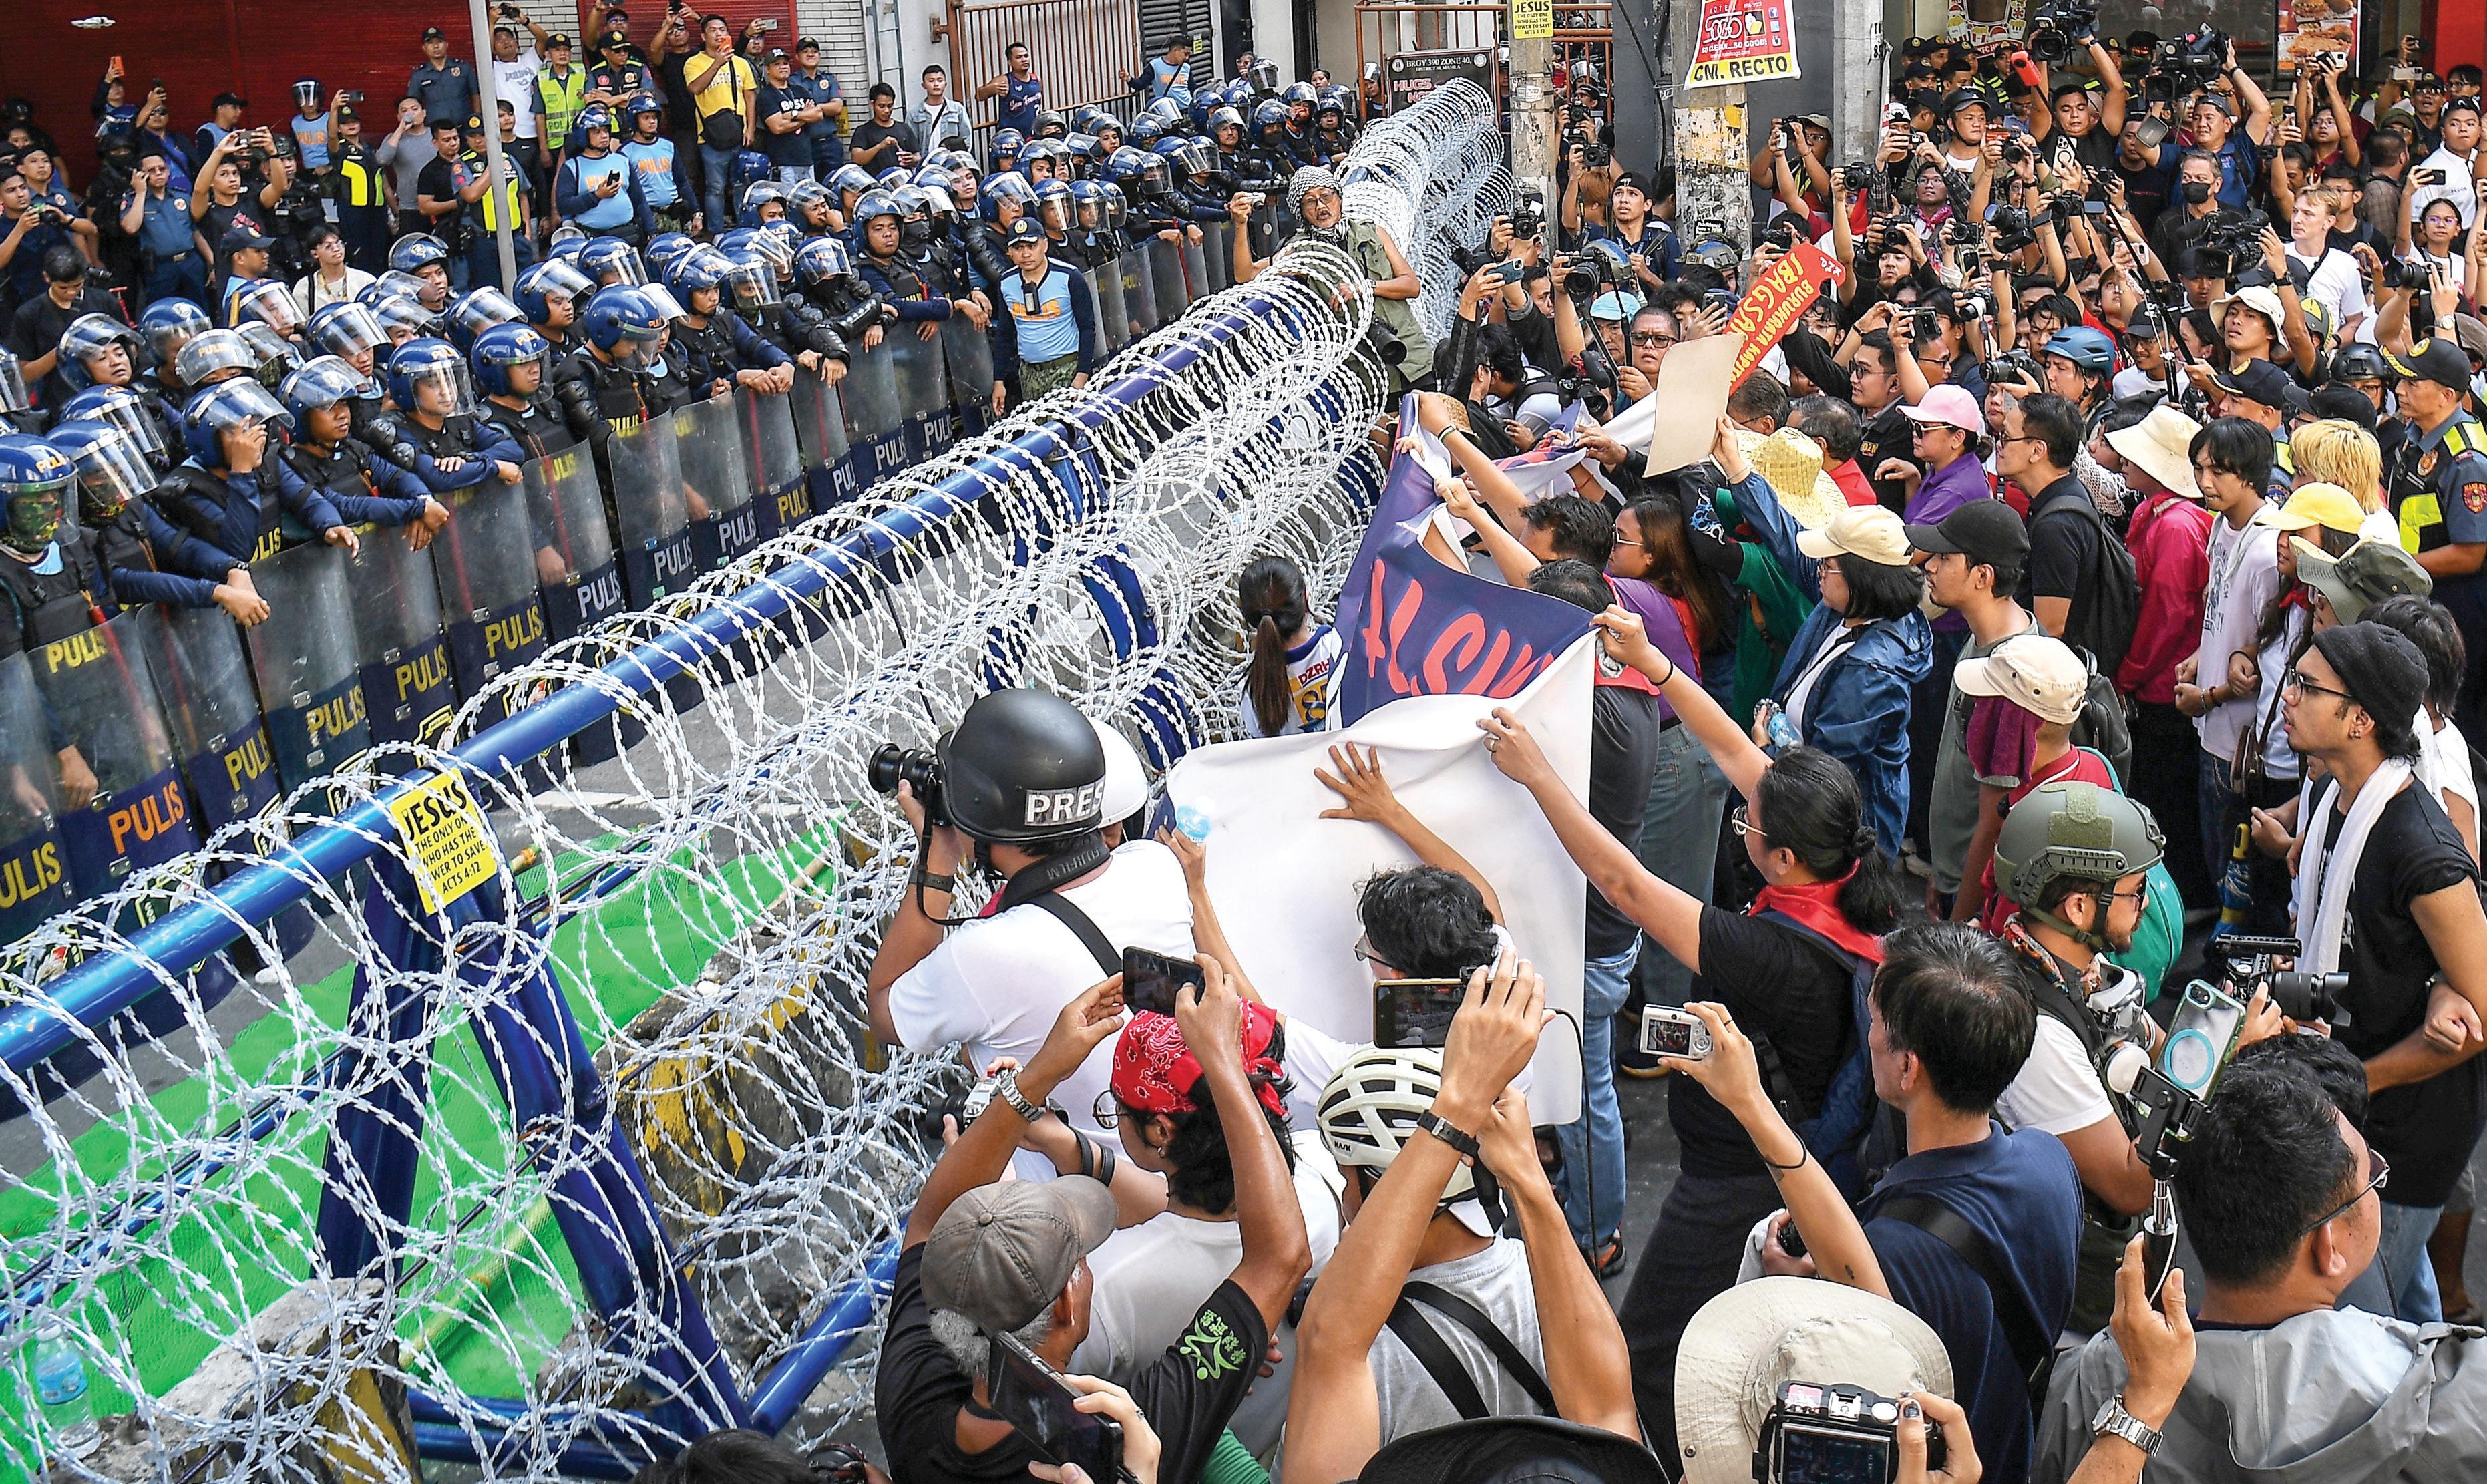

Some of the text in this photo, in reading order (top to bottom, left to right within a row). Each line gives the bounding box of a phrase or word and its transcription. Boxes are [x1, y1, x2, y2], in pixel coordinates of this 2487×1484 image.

[1514, 1, 1550, 13] JESUS
[1406, 59, 1428, 68] BRGY
[1427, 58, 1440, 67] 390
[1440, 57, 1461, 66] ZONE
[1730, 56, 1788, 79] RECTO
[1393, 78, 1432, 92] HUGS
[1730, 342, 1762, 386] KAPITA
[832, 459, 857, 498] PUL
[249, 526, 282, 564] LIS
[718, 509, 757, 553] PULIS
[654, 535, 693, 582] PULIS
[576, 568, 622, 619] PULIS
[484, 604, 544, 659] PULIS
[395, 642, 448, 702] PULIS
[1297, 657, 1331, 686] DZRH
[305, 684, 367, 748] PULIS
[108, 780, 184, 855] PULIS
[403, 779, 467, 842] JESUS
[1026, 776, 1105, 824] PRES
[414, 812, 474, 854] THE ONLY ON
[422, 825, 477, 868] WHO HAS THE
[0, 840, 62, 909] ULIS
[441, 860, 483, 894] ACTS 4:12
[451, 854, 464, 872] TO
[464, 840, 489, 861] SAVE
[1046, 848, 1101, 881] FUJIFILM
